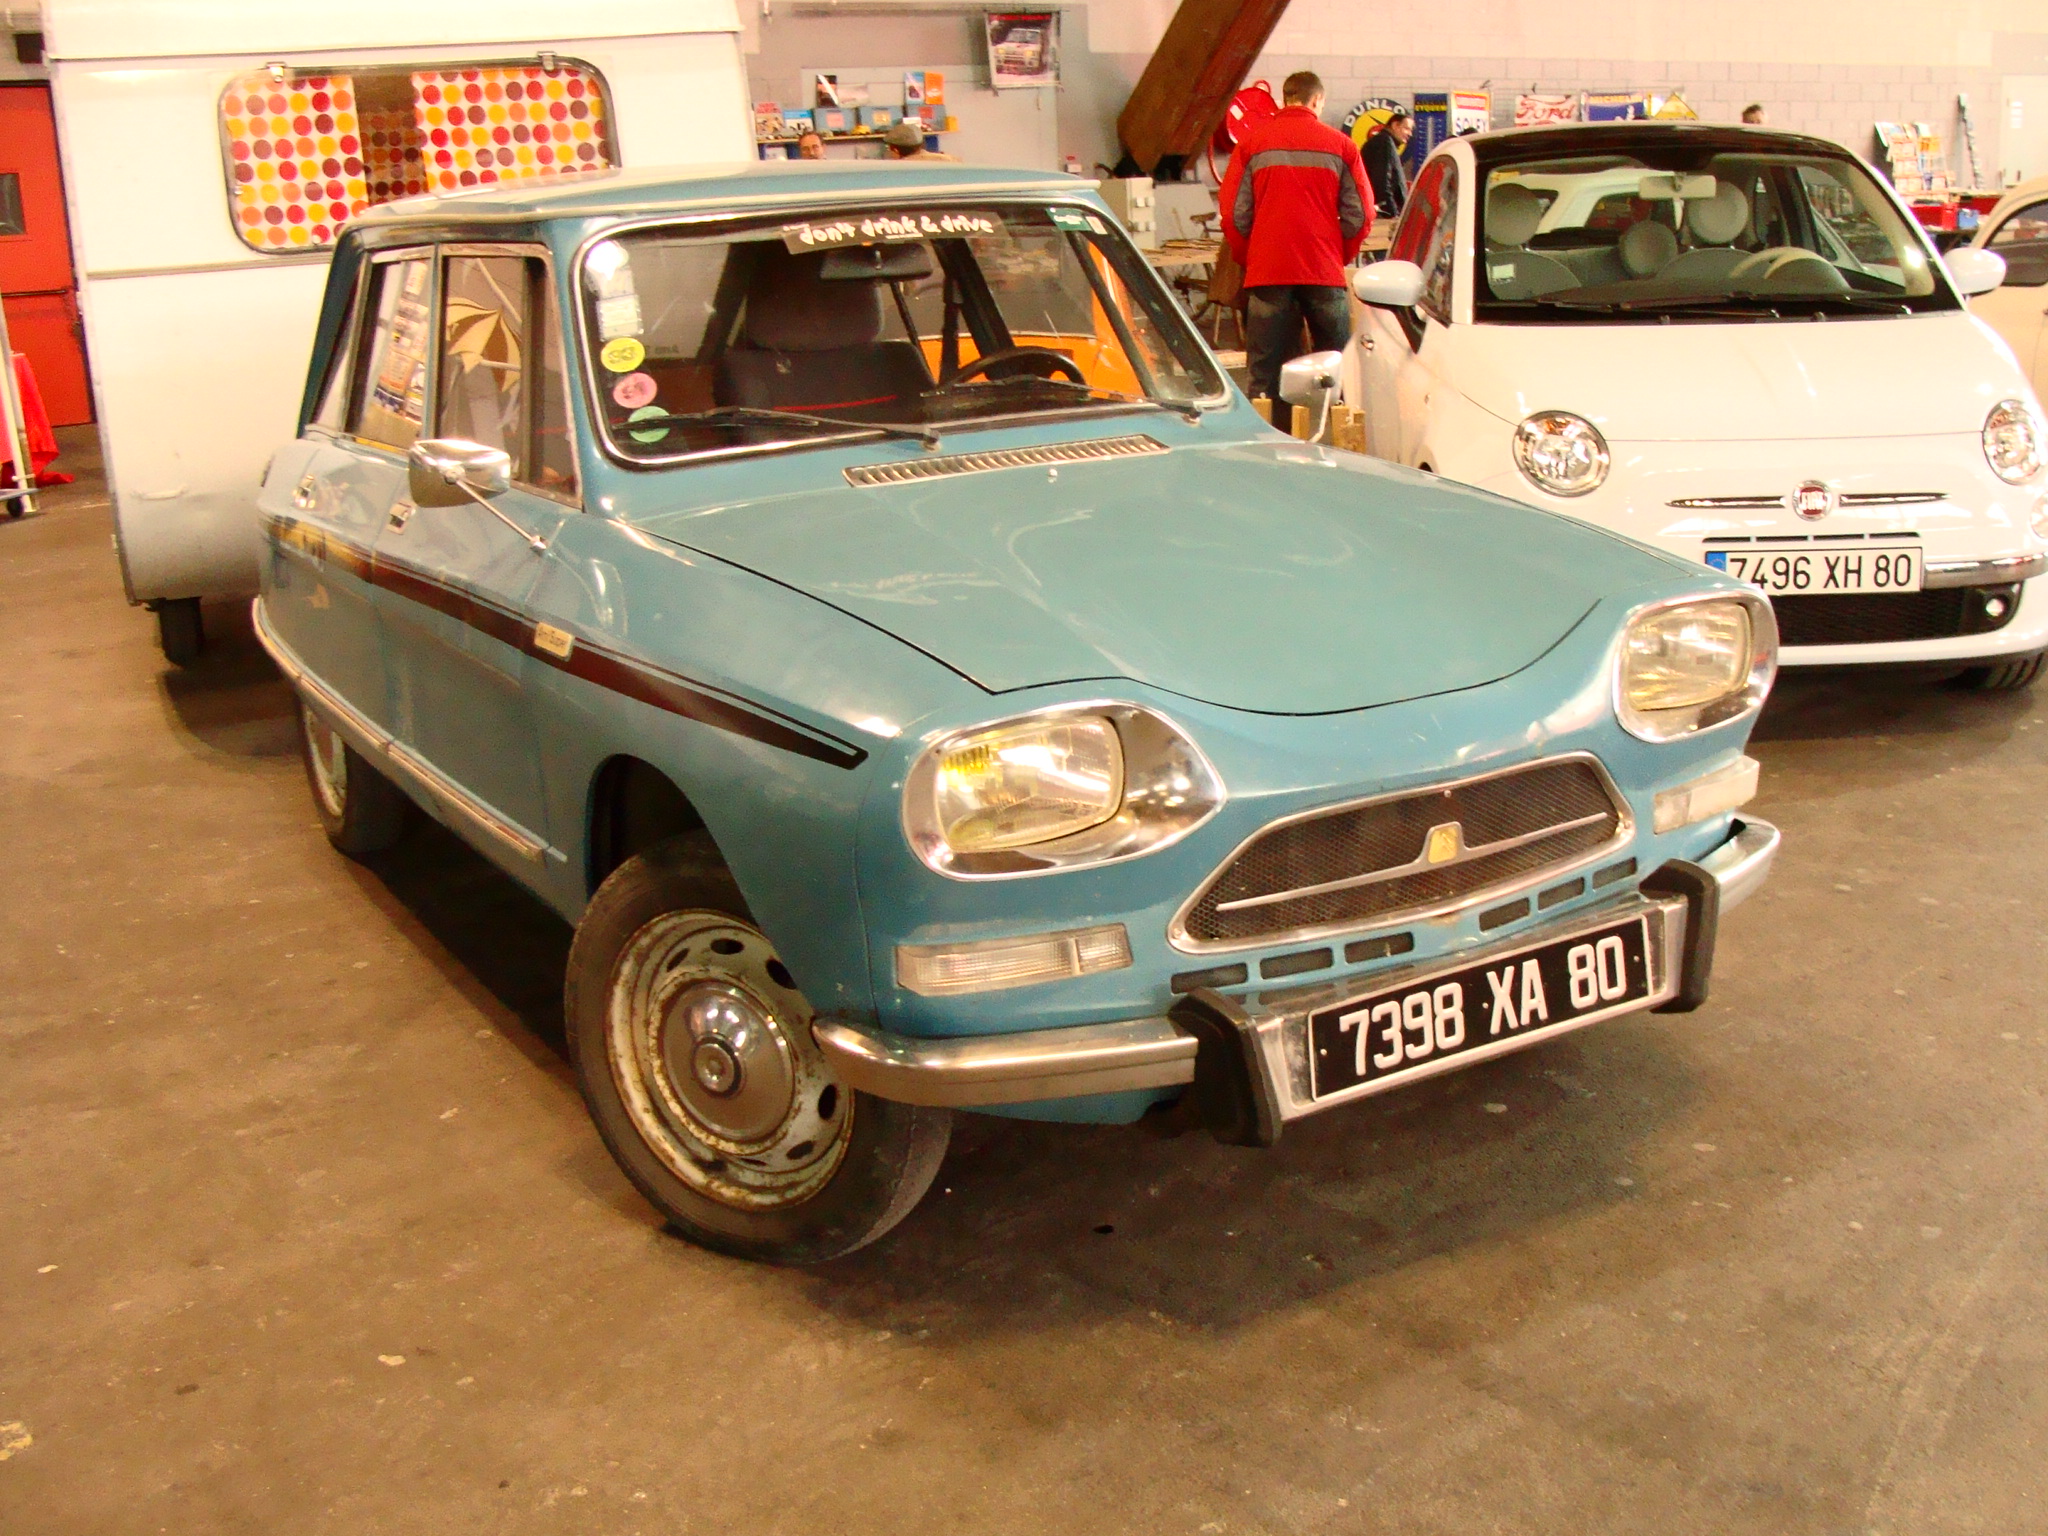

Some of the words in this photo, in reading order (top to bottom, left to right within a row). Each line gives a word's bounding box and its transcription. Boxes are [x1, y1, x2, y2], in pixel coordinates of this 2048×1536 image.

[1344, 98, 1407, 128] DUNLO
[1516, 100, 1576, 121] Ford
[861, 215, 917, 236] drink
[920, 215, 941, 233] &
[940, 214, 994, 234] drive
[1729, 556, 1811, 589] 7496
[1823, 555, 1862, 588] XH
[1873, 554, 1912, 587] 80
[1339, 981, 1465, 1076] 7398
[1486, 958, 1548, 1035] XA
[1567, 935, 1627, 1009] 80
